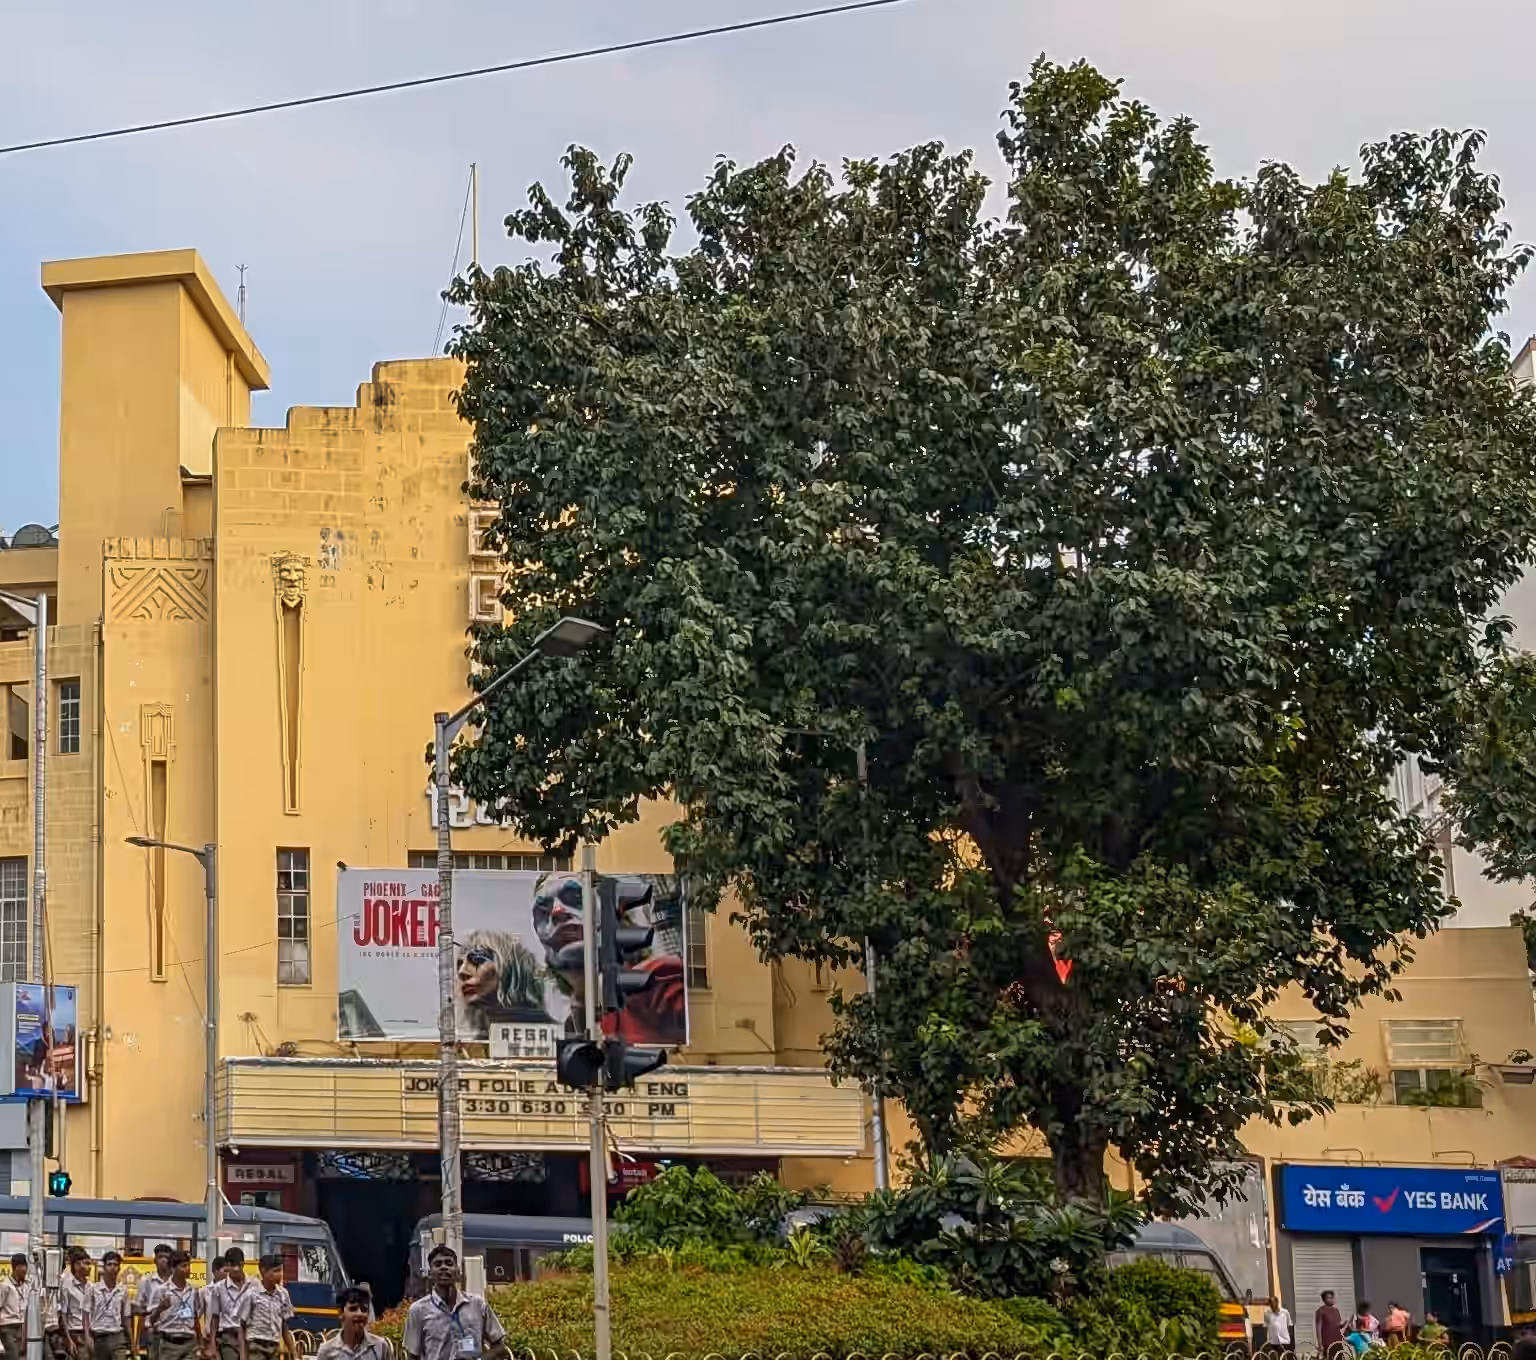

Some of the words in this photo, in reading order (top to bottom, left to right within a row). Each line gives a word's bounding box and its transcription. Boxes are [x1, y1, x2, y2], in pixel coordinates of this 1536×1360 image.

[421, 883, 441, 897] GAG
[406, 1078, 470, 1093] JOKR
[480, 1079, 536, 1093] FOLIE
[545, 1080, 559, 1094] A
[647, 1082, 688, 1096] ENG
[465, 1099, 510, 1113] 3:30
[521, 1100, 566, 1114] 6:30
[649, 1103, 675, 1116] PM
[235, 1167, 288, 1180] REGAL
[52, 1177, 66, 1192] 17
[1303, 1184, 1331, 1209] येस
[1336, 1183, 1366, 1209] बँक
[1403, 1191, 1437, 1209] YES
[1440, 1192, 1489, 1211] BANK
[563, 1233, 594, 1244] POLIC
[1496, 1256, 1513, 1271] AT
